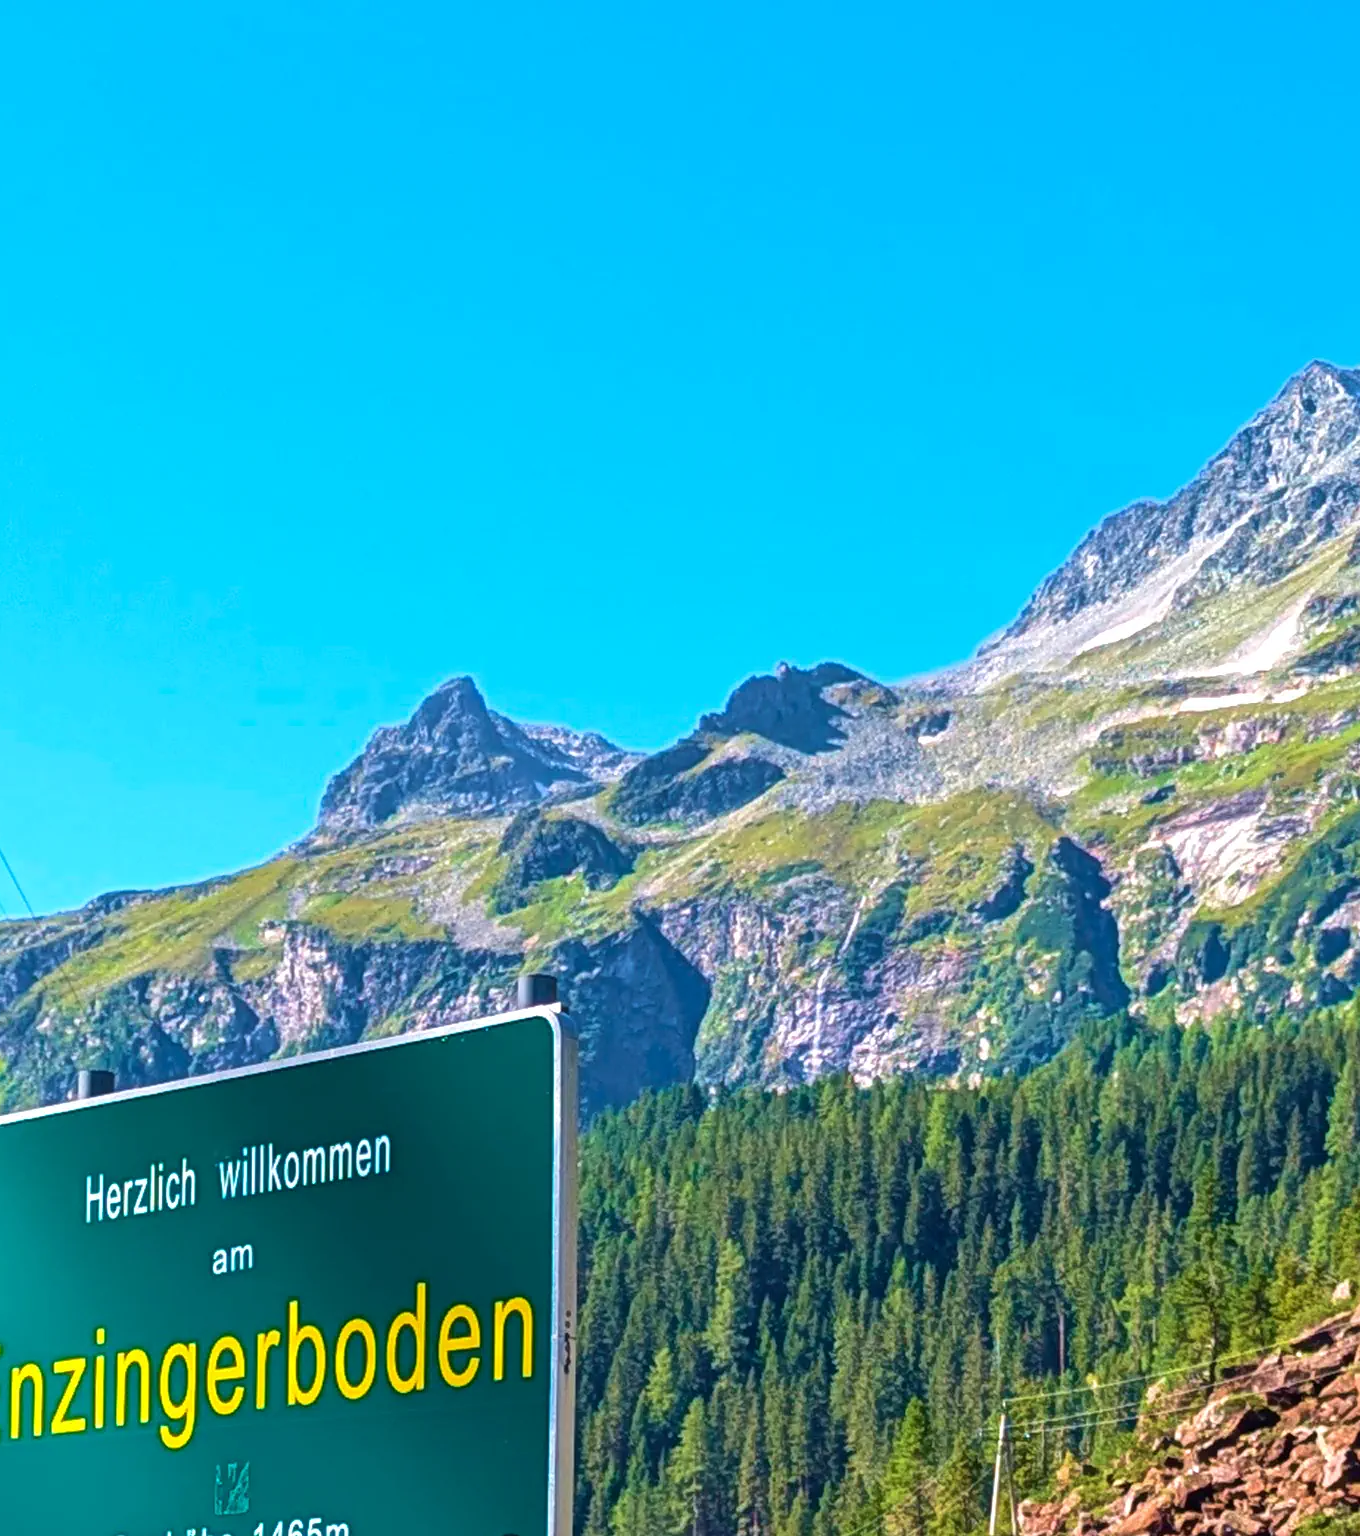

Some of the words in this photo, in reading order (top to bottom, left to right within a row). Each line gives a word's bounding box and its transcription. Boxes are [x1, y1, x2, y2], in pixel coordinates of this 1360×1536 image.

[85, 1157, 197, 1224] Herzlich
[218, 1134, 391, 1200] willkommen
[212, 1243, 254, 1275] am
